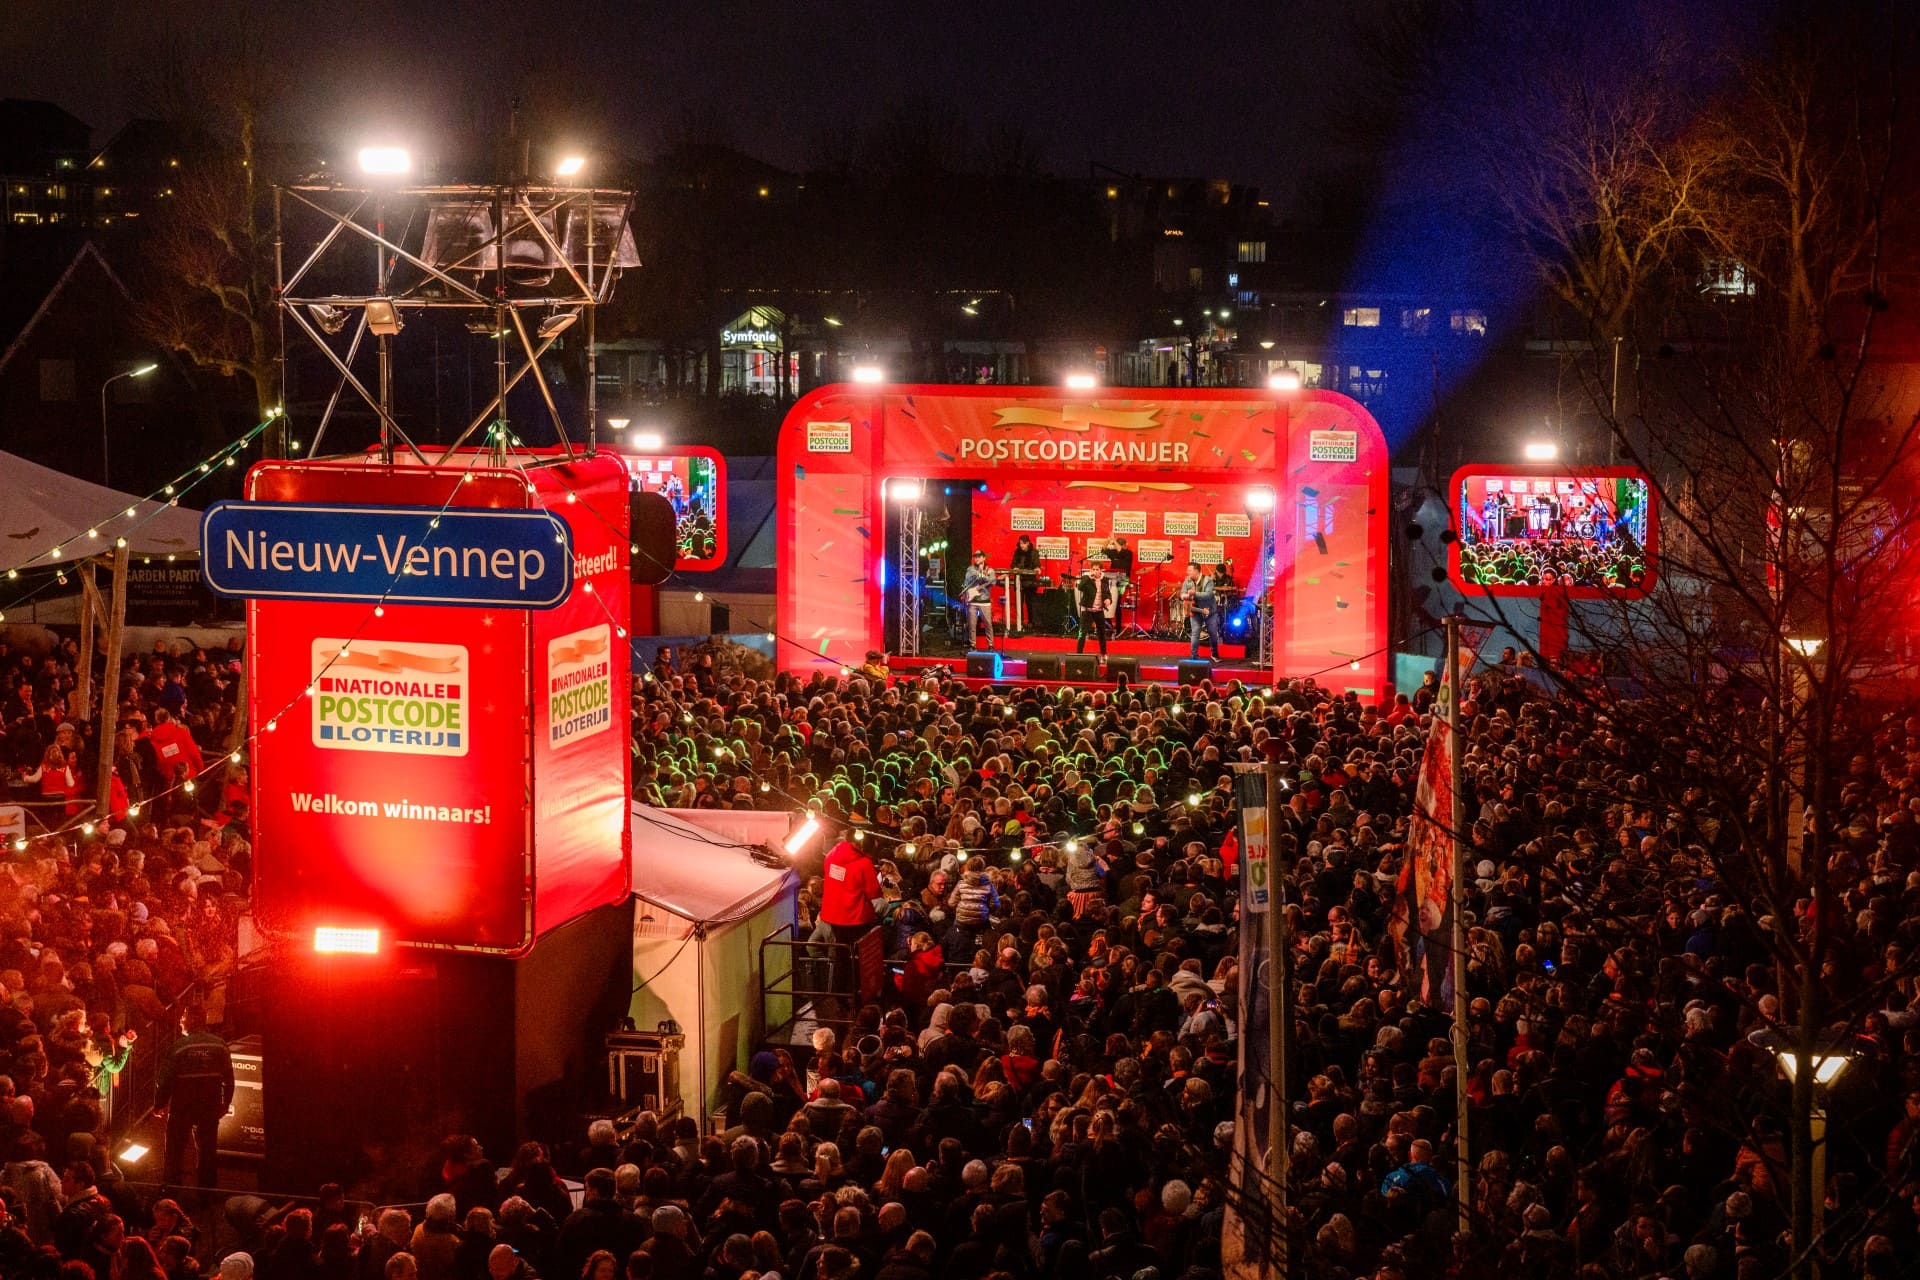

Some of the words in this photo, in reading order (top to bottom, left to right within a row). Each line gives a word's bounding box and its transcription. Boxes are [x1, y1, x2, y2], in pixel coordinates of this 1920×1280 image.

[723, 330, 776, 344] Symfonie
[810, 437, 849, 445] POSTCODE
[961, 438, 1189, 463] POSTCODEKANJER
[1312, 446, 1354, 455] POSTCODE
[225, 529, 545, 590] Nieuw-Vennep
[1191, 552, 1222, 560] POSTCODE
[169, 569, 201, 582] PARTY
[335, 678, 445, 699] NATIONALE
[556, 663, 602, 691] NATIONALE
[319, 695, 461, 729] POSTCODE
[551, 679, 608, 723] POSTCODE
[336, 726, 444, 747] LOTERIJ
[558, 712, 602, 738] LOTERIJ
[290, 792, 378, 817] Welkom
[383, 798, 491, 825] winnaars!
